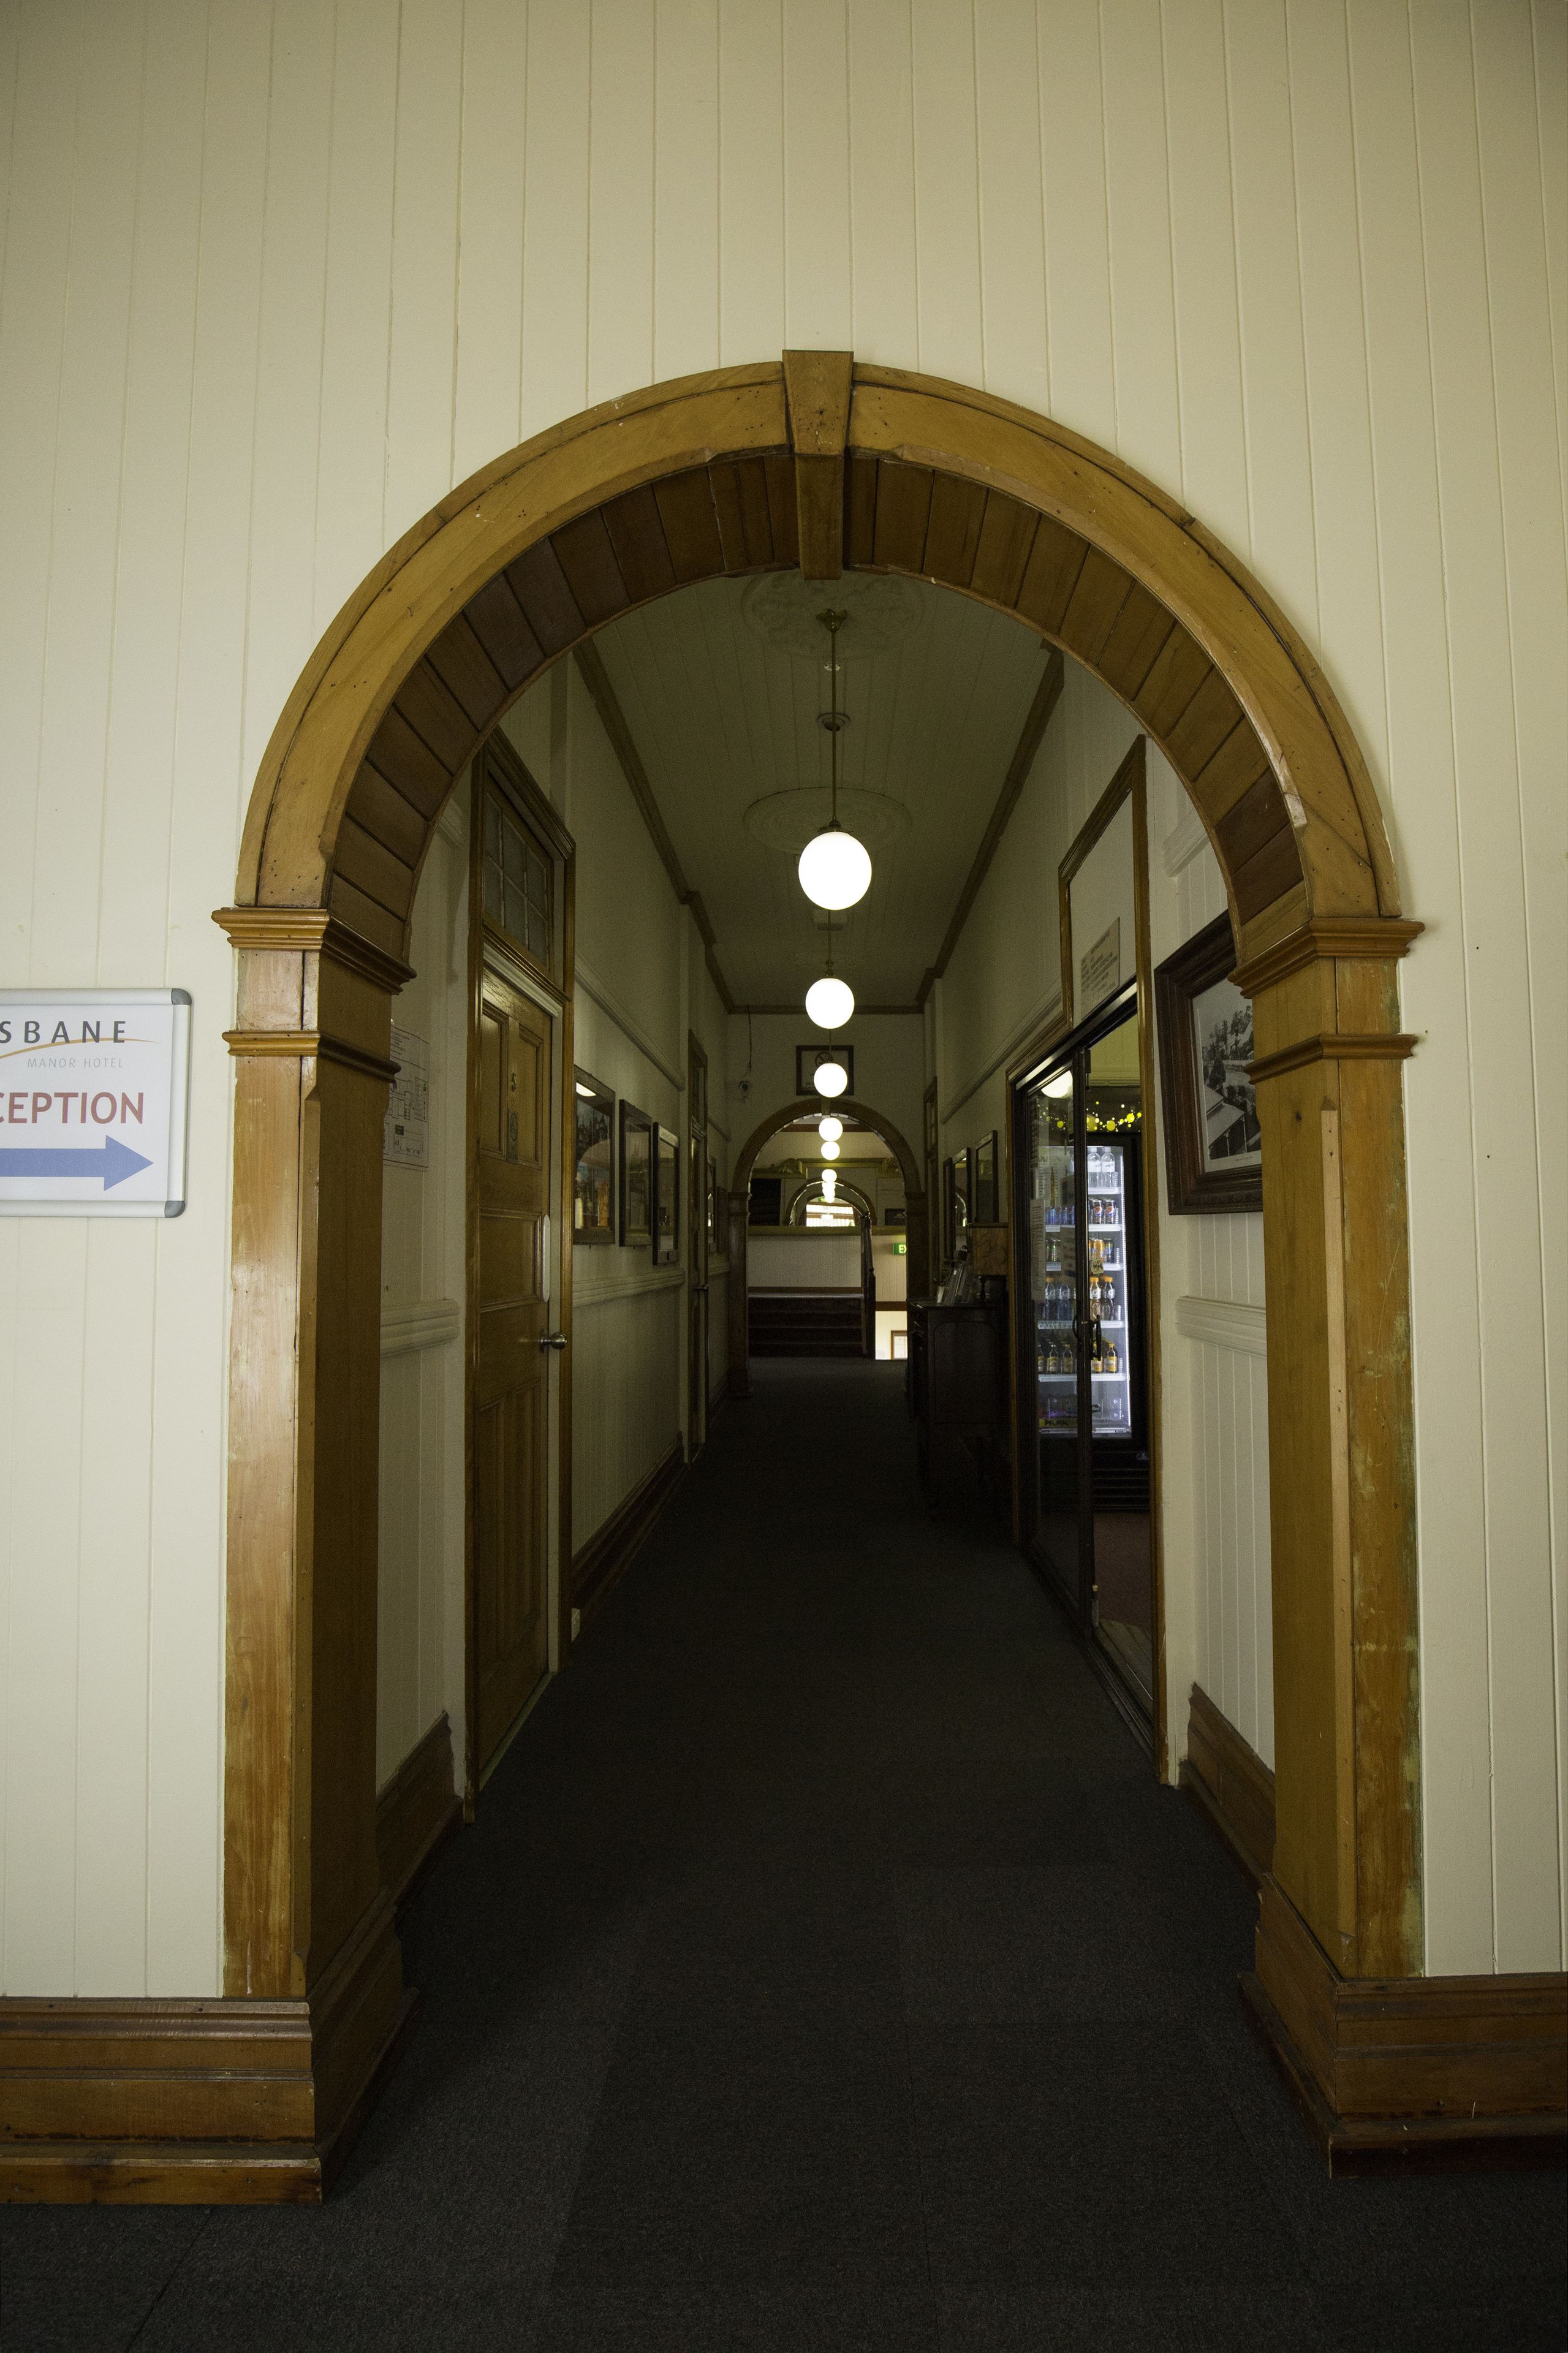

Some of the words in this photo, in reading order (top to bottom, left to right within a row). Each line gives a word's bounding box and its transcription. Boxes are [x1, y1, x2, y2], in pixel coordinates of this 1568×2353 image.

[27, 1058, 76, 1069] MANOR
[83, 1058, 123, 1069] HOTEL
[0, 1092, 144, 1124] EPTION
